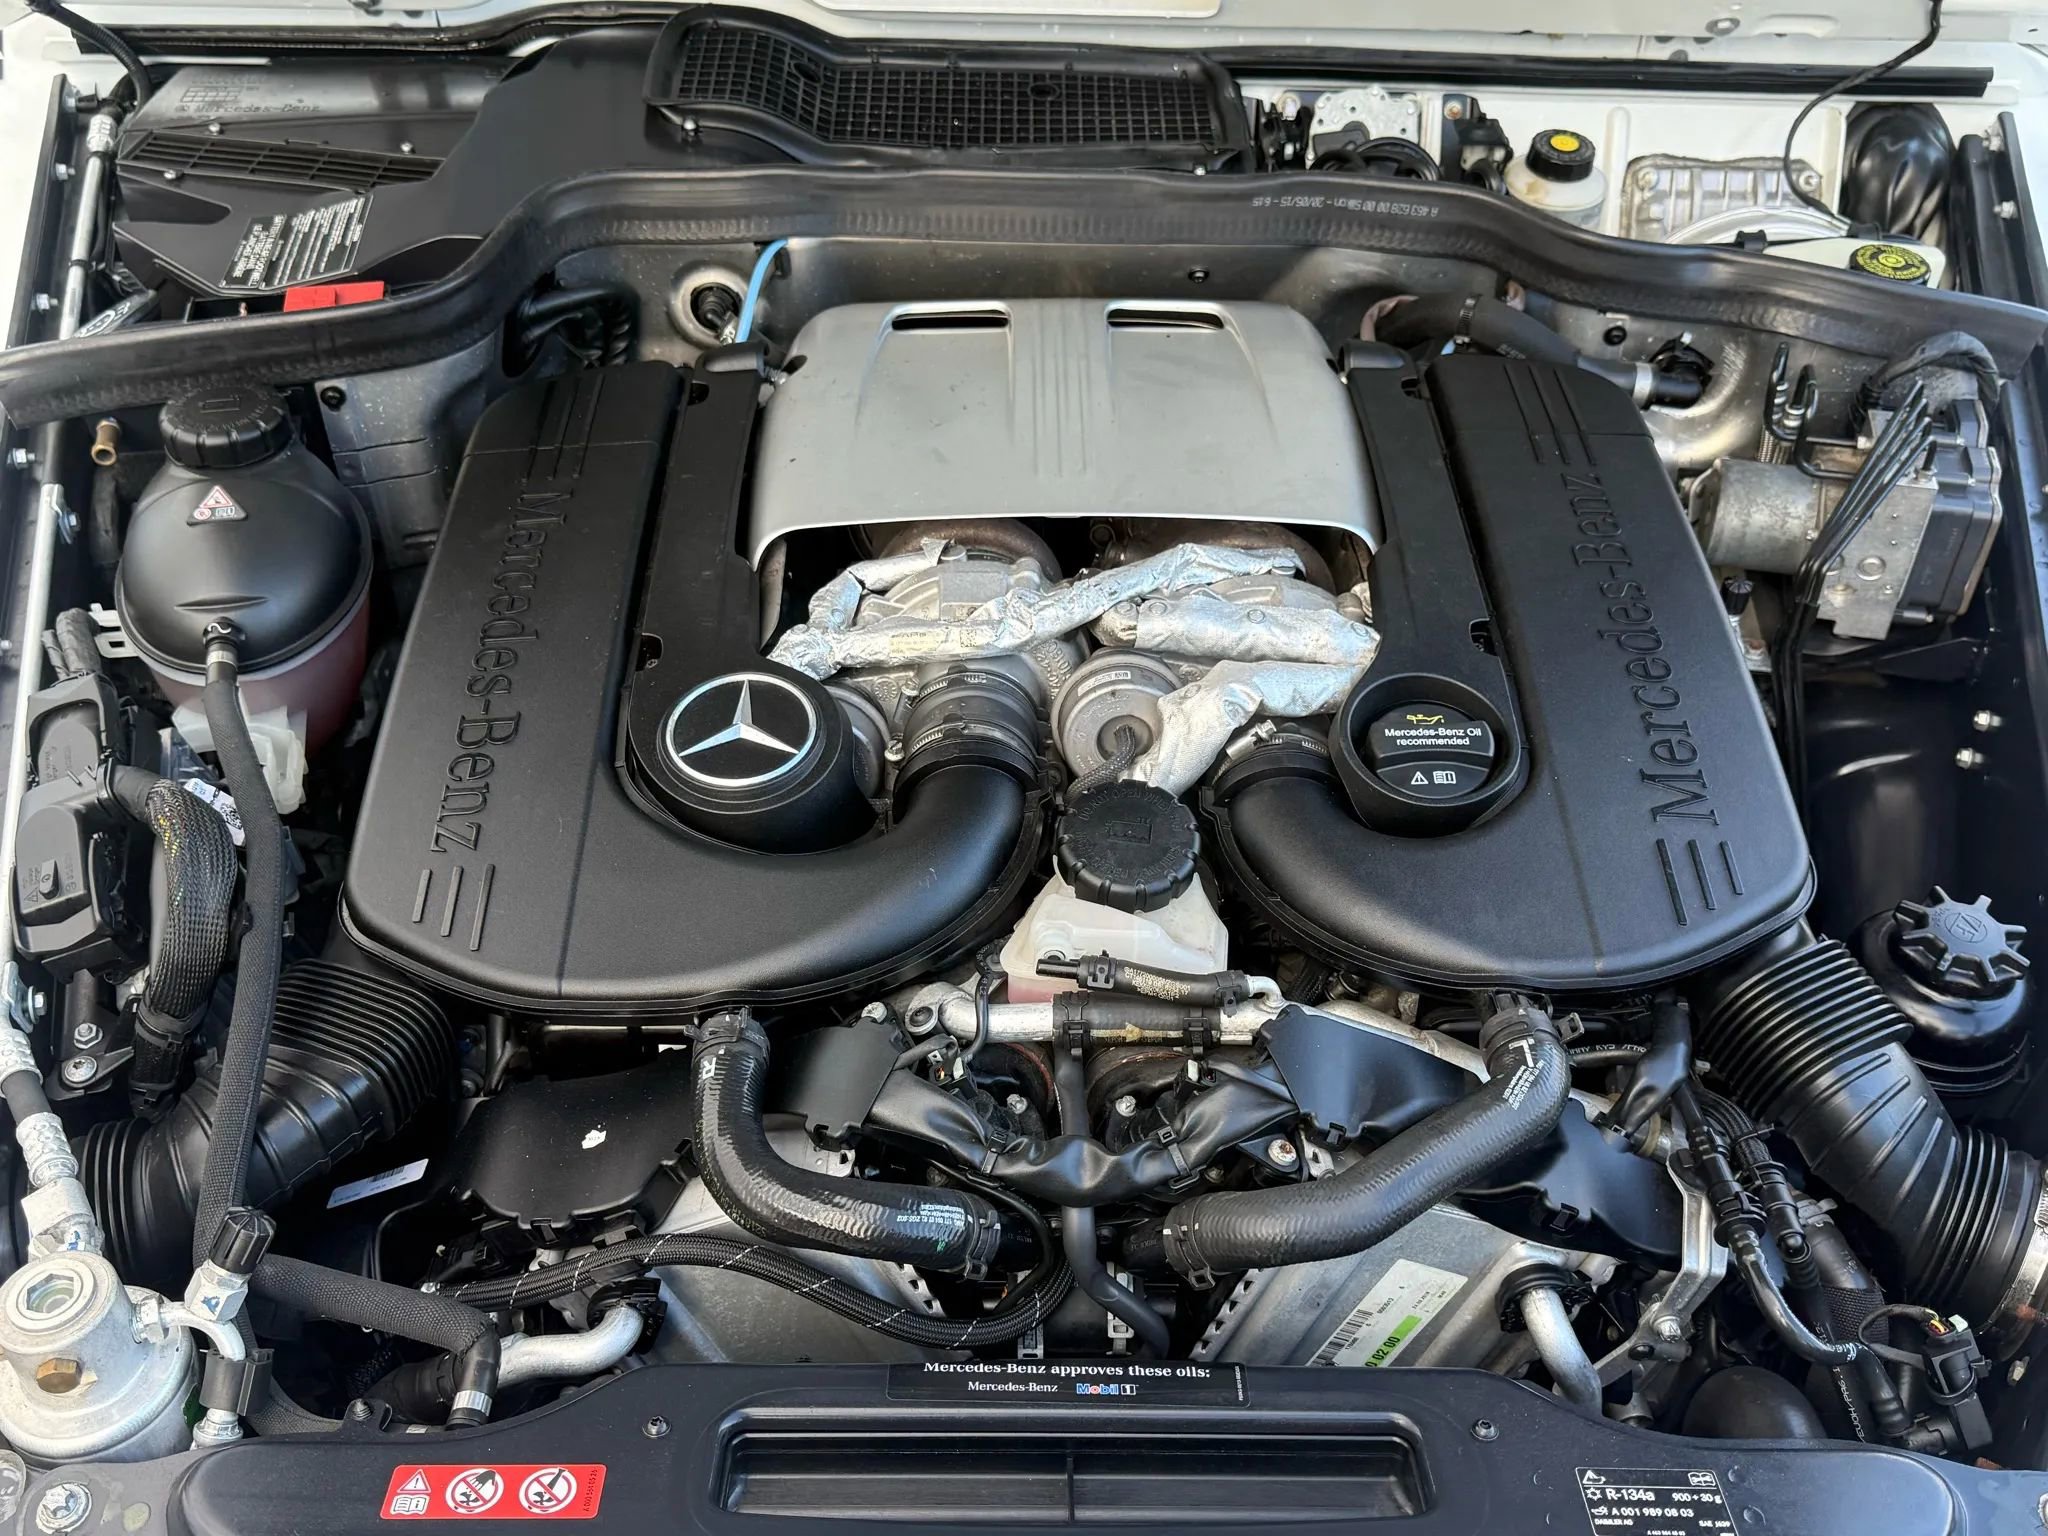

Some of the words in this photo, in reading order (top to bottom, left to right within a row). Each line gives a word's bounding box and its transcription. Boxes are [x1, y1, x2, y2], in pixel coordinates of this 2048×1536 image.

[1561, 471, 1721, 826] Mercedes-Benz
[430, 488, 574, 853] Mercedes-Benz
[1385, 727, 1465, 737] Mercedes-Benz
[1467, 727, 1482, 736] Oil
[1396, 737, 1470, 746] recommended
[1372, 1348, 1390, 1361] 02
[1383, 1336, 1401, 1348] 00
[923, 1362, 1046, 1374] Mercedes-Benz
[1051, 1364, 1124, 1377] approves
[1128, 1366, 1172, 1377] these
[1176, 1367, 1211, 1378] oils:
[967, 1381, 1058, 1393] Mercedes-Benz
[1076, 1383, 1119, 1395] Mobil
[1605, 1488, 1655, 1501] R-134a
[1672, 1492, 1692, 1502] 900
[1611, 1508, 1620, 1516] A
[1620, 1508, 1640, 1516] 001
[1642, 1508, 1663, 1517] 989
[1664, 1508, 1679, 1517] 08
[1679, 1508, 1694, 1518] 03
